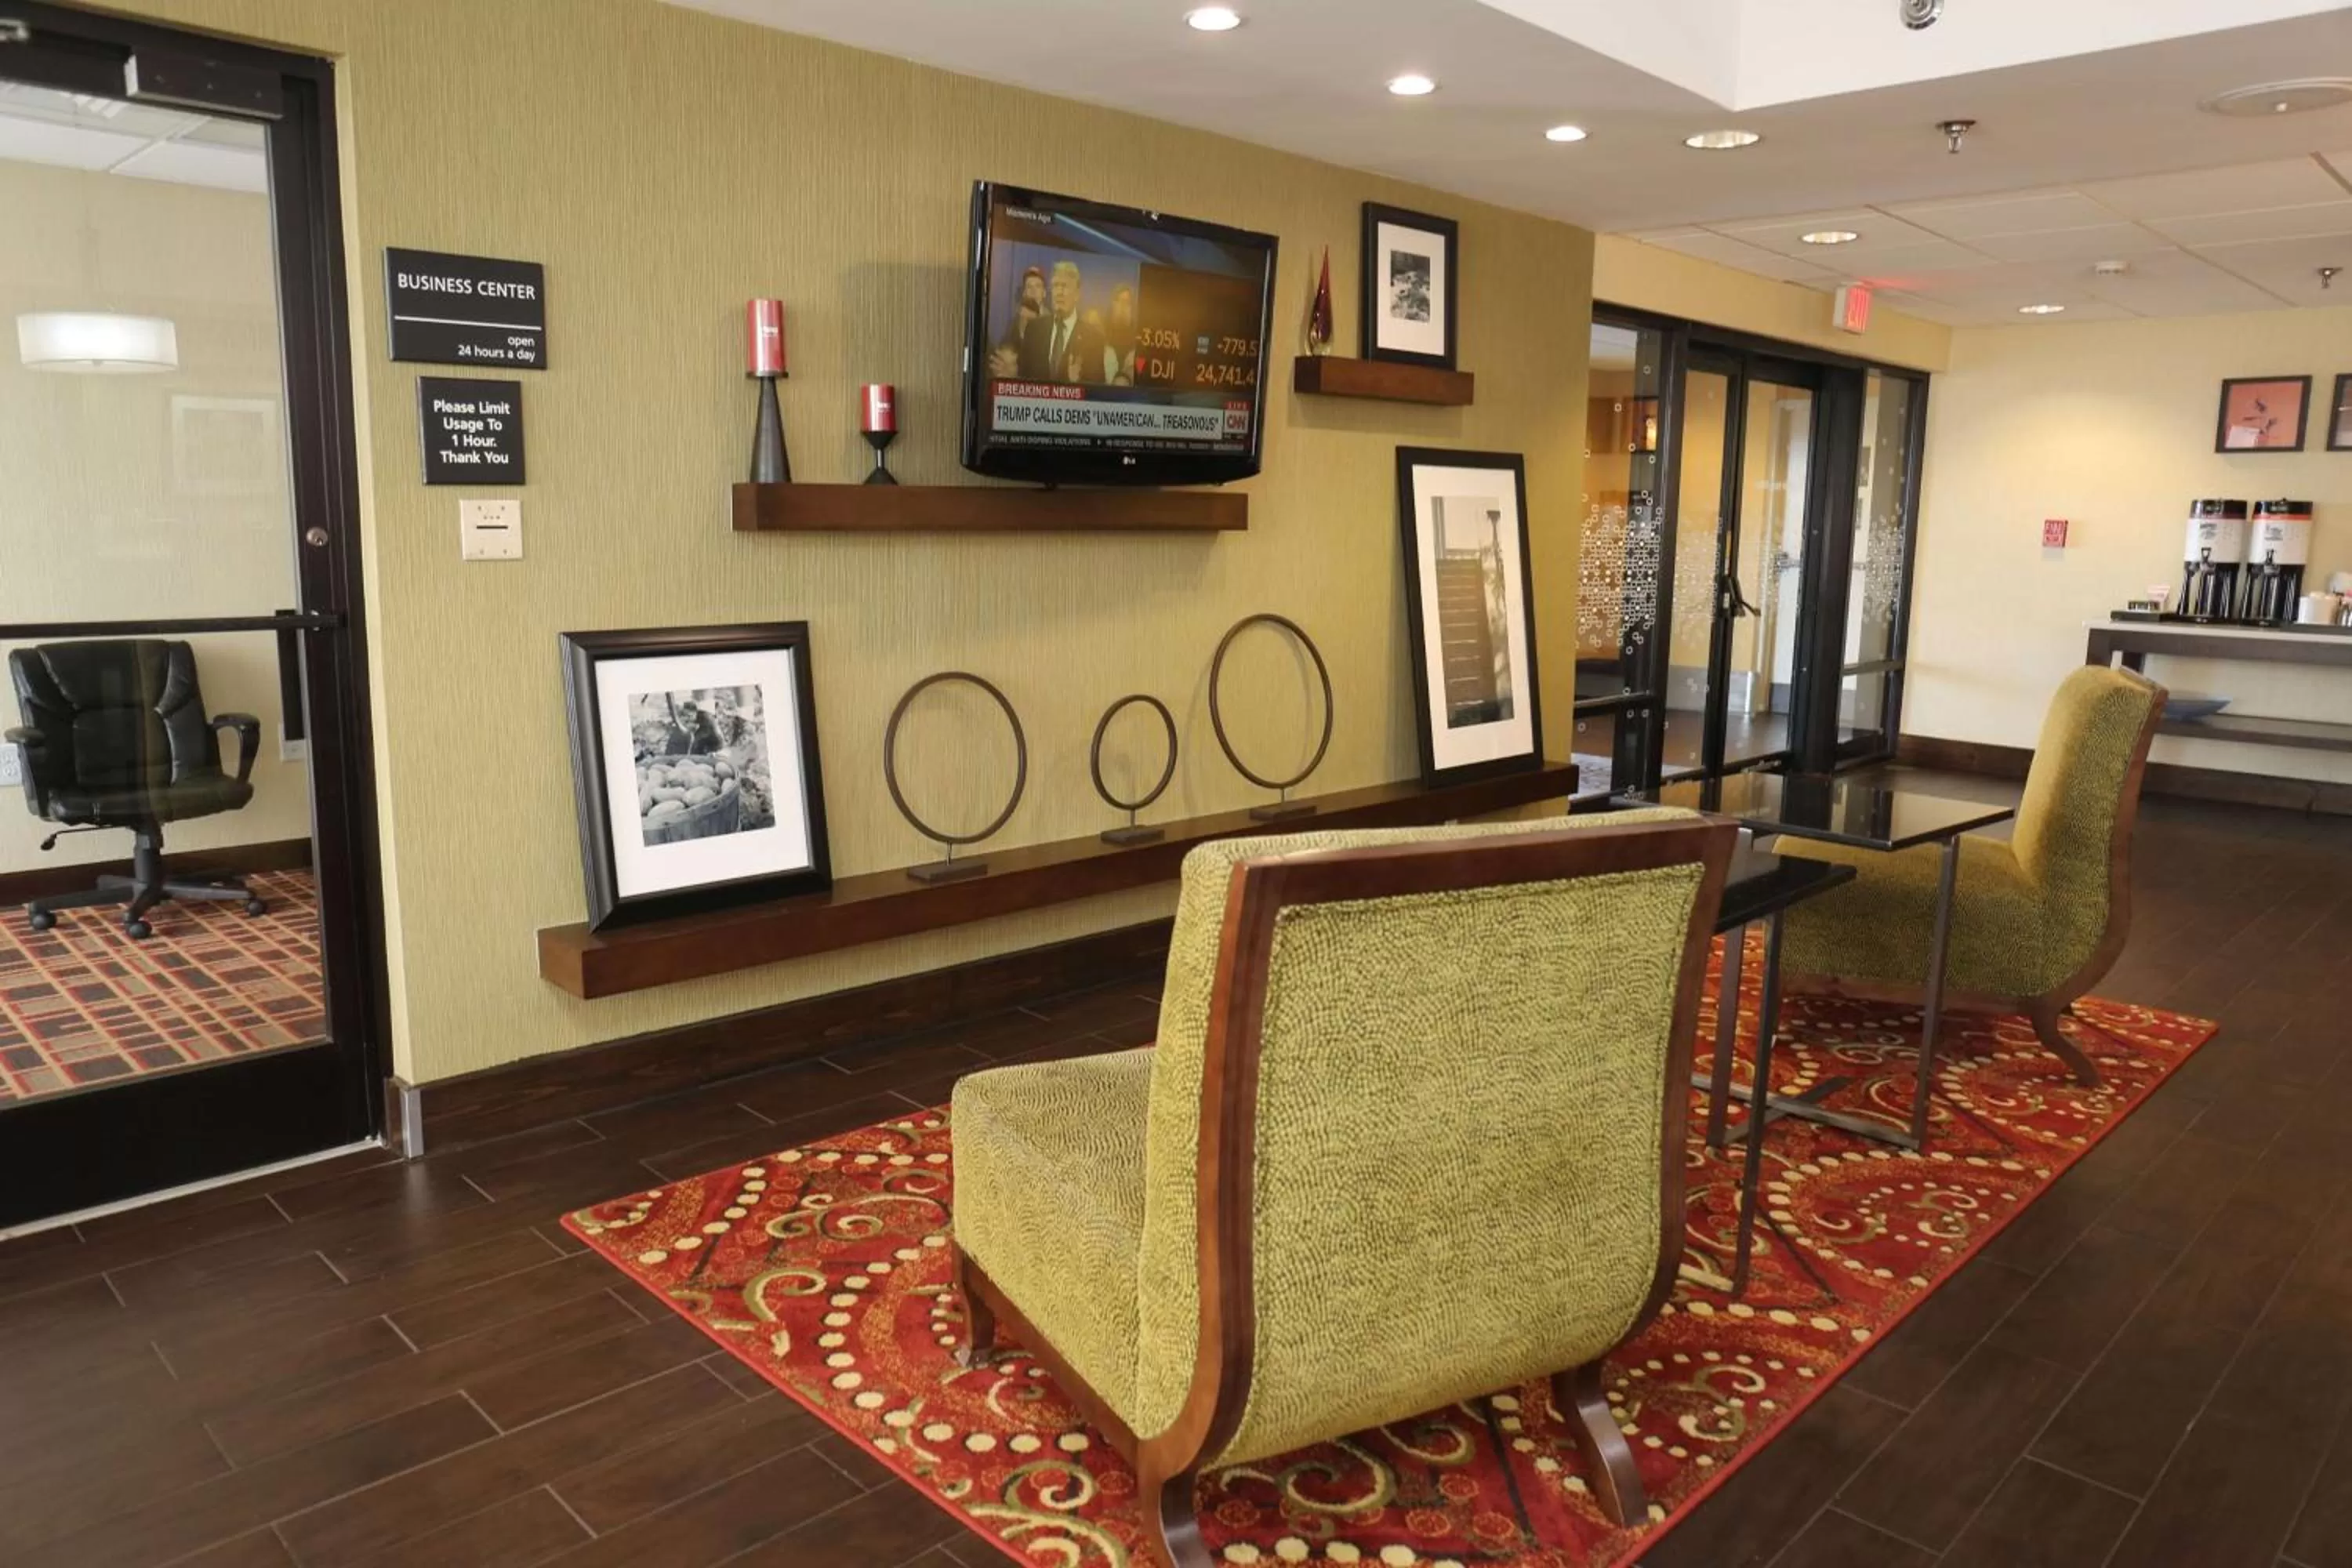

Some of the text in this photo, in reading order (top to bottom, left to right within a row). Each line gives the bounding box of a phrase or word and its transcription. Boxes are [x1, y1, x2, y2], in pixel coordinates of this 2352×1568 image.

[397, 273, 536, 300] BUSINESS CENTER
[507, 336, 535, 348] open
[1135, 328, 1180, 350] -3.05%
[458, 344, 535, 363] 24 hours a day
[1150, 358, 1175, 380] DJI
[998, 382, 1082, 399] BREAKING NEWS
[434, 398, 510, 415] Please Limit
[997, 405, 1031, 422] TRUMP
[1033, 407, 1062, 423] CALLS
[1065, 409, 1091, 425] DEMS
[443, 416, 503, 434] Usage To
[452, 434, 497, 448] 1 Hour.
[439, 450, 509, 463] Thank You
